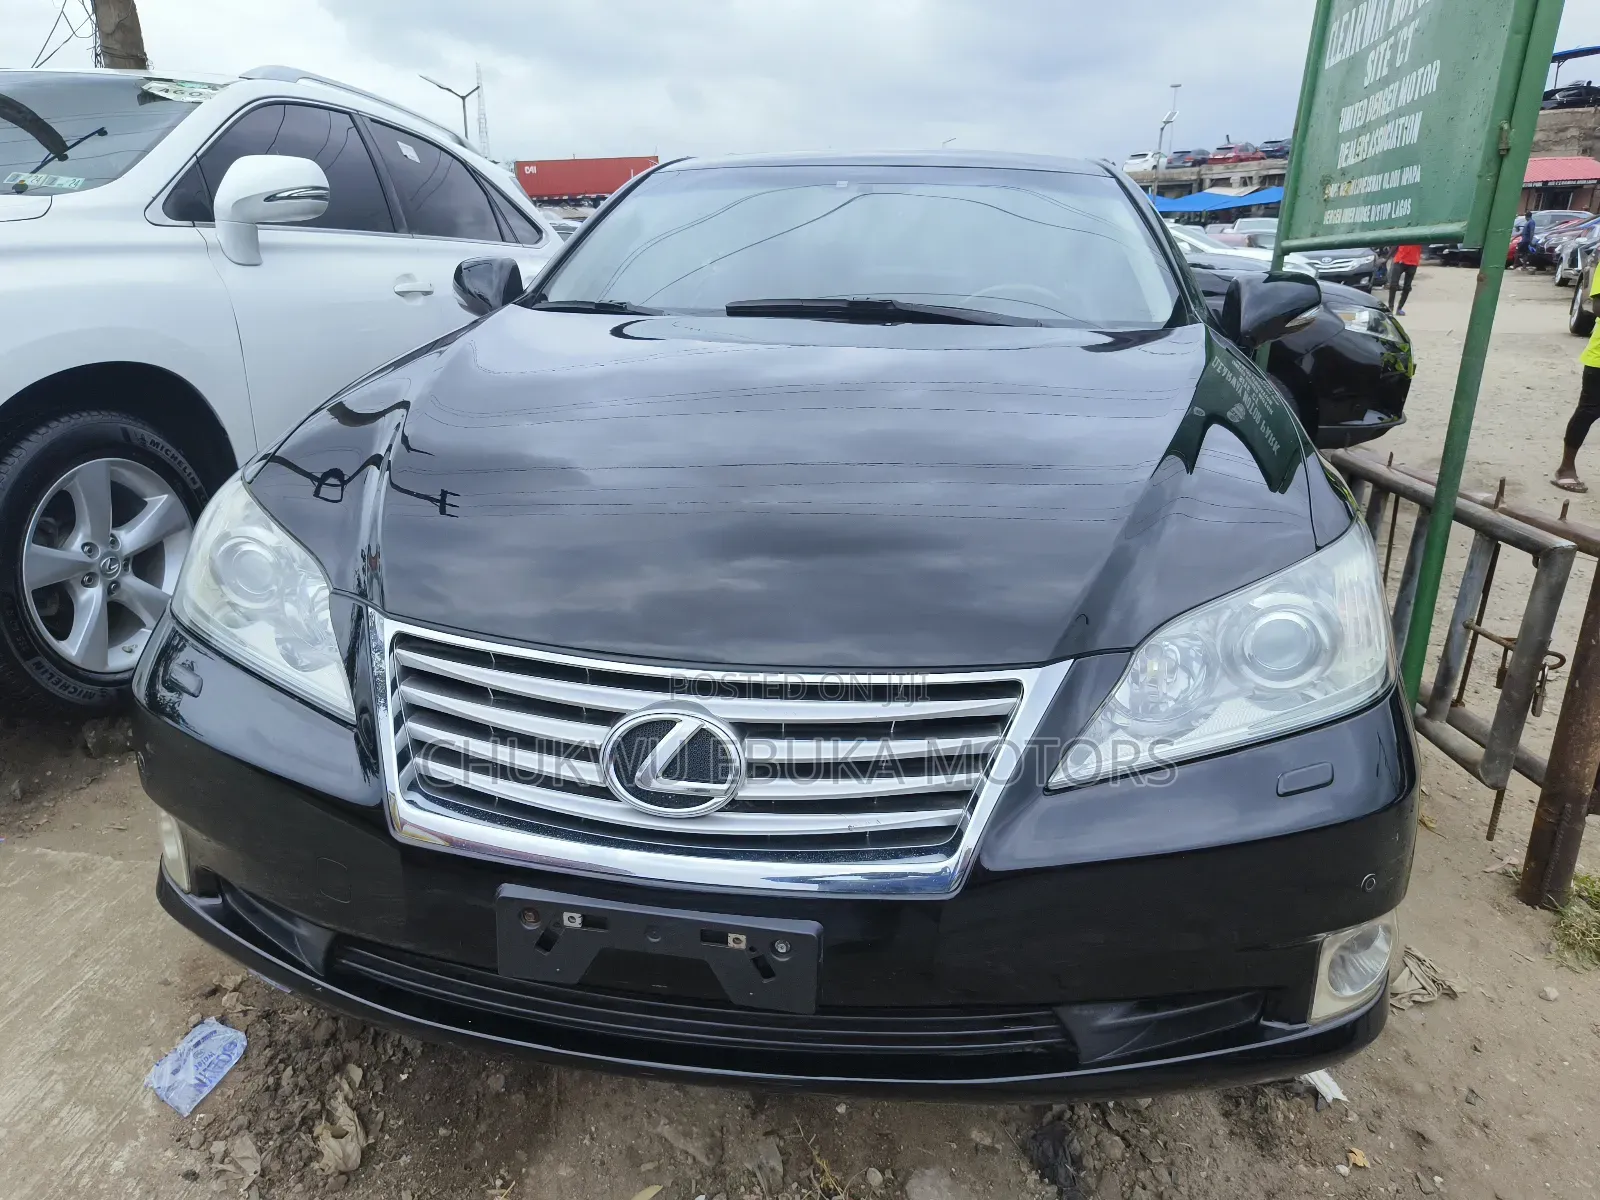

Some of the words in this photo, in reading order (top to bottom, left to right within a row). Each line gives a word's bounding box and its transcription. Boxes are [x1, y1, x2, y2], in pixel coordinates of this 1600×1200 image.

[1364, 36, 1395, 88] SITE
[1339, 98, 1369, 133] UNITED
[1366, 81, 1399, 123] BERGER
[1398, 60, 1440, 107] MOTOR
[524, 165, 537, 174] CAI
[1391, 198, 1412, 219] LAGOS
[149, 438, 199, 487] MICHELIN
[32, 660, 97, 701] MICHELIN
